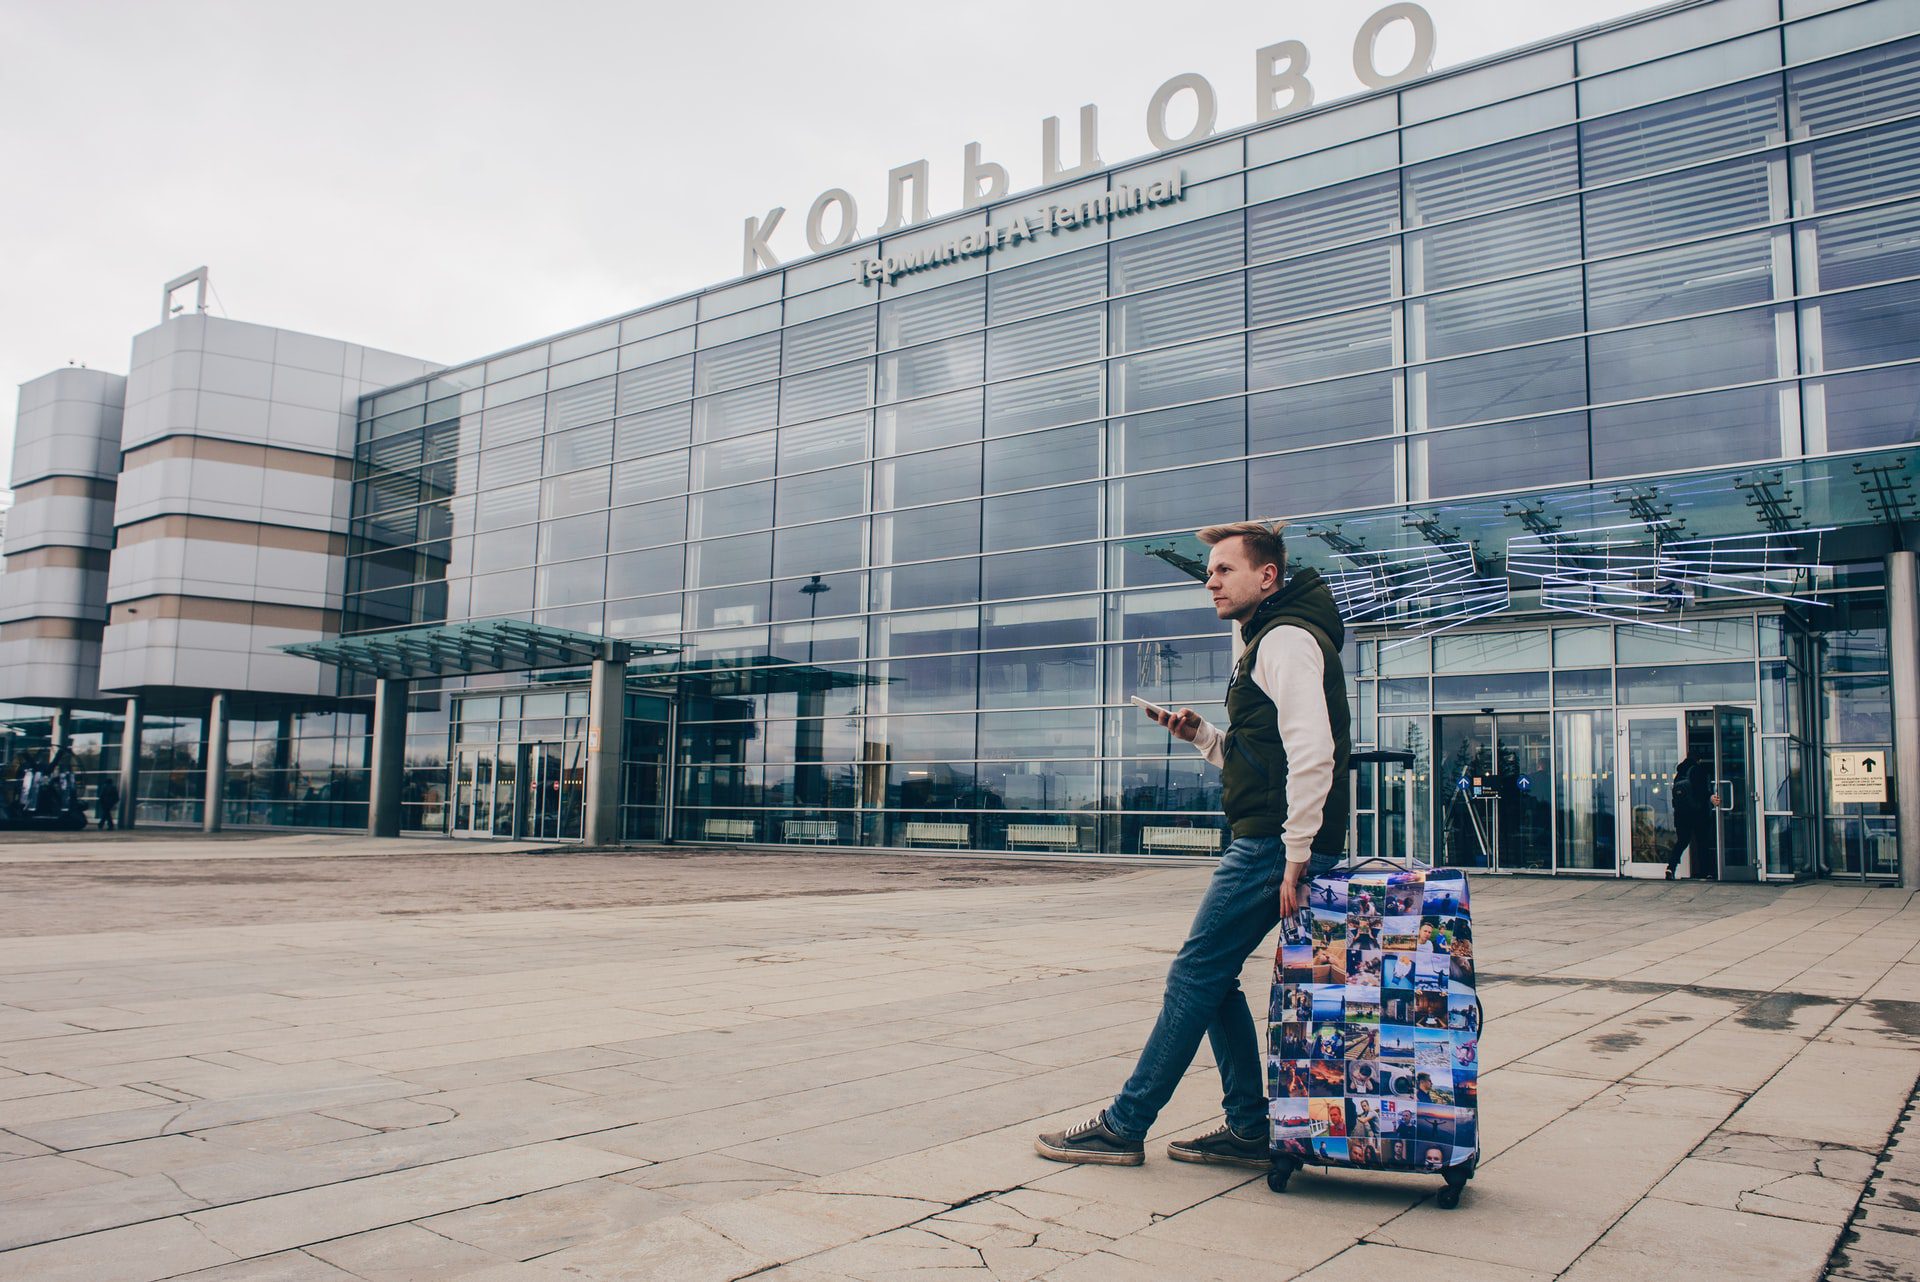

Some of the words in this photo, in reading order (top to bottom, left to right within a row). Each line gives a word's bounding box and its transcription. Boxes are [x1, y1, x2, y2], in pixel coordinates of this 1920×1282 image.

[743, 3, 1437, 275] КОЛЬЦОВО
[853, 222, 1000, 285] Терминал
[1039, 166, 1182, 232] Terminal
